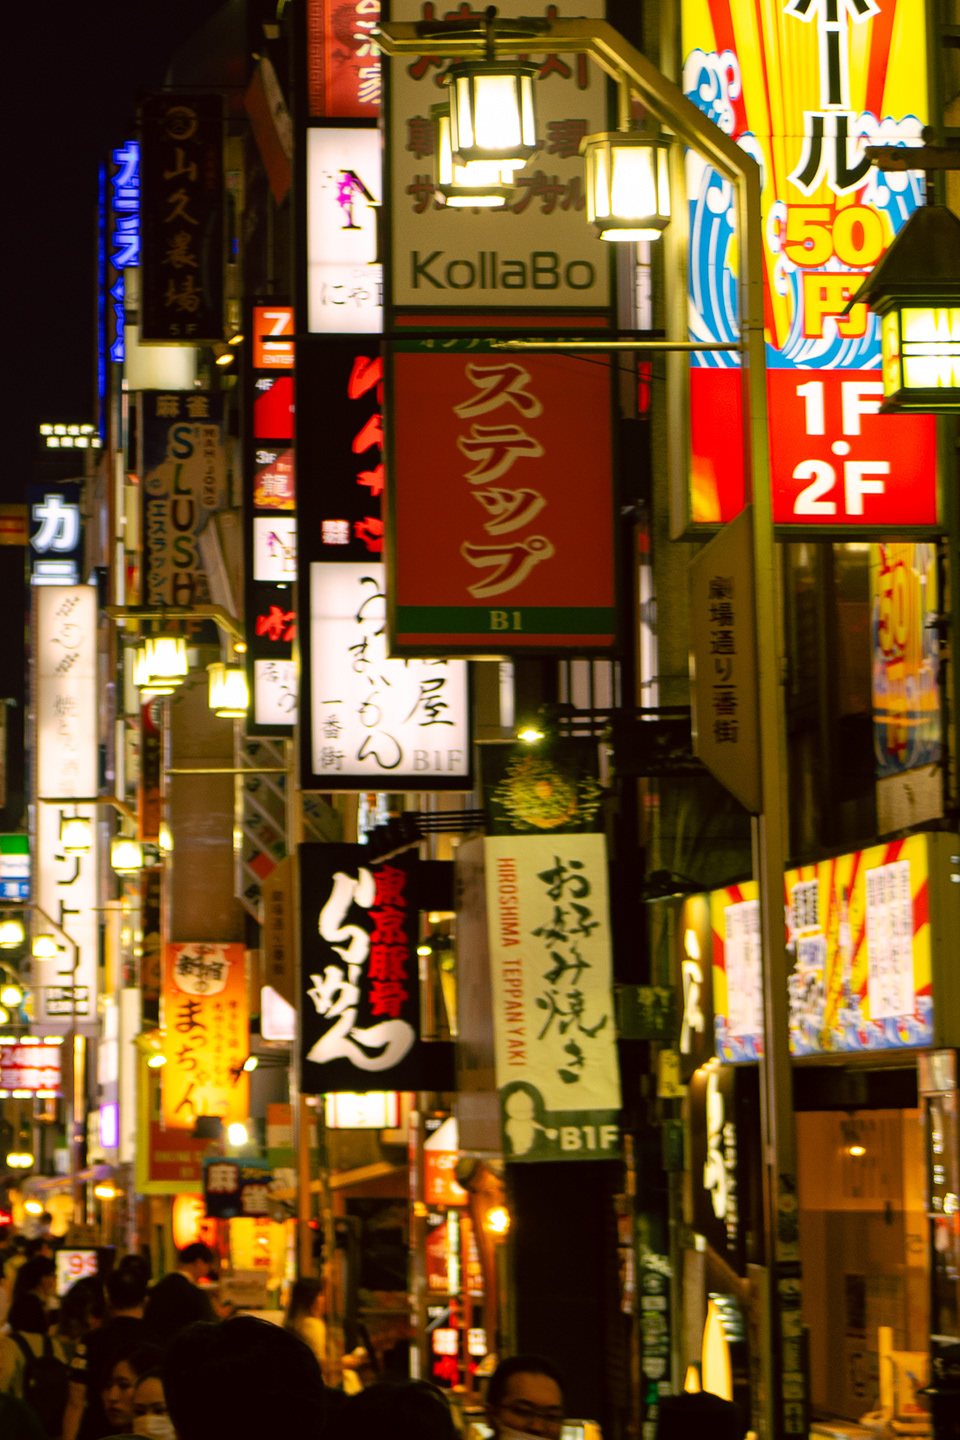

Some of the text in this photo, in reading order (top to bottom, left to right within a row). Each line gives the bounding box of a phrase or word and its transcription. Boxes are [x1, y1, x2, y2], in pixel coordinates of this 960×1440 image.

[784, 203, 885, 269] 50
[409, 251, 595, 290] KollaBo
[168, 323, 199, 336] 5F
[800, 271, 870, 340] 円
[156, 394, 211, 419] 麻雀
[796, 380, 884, 436] 1F
[453, 362, 555, 599] ステップ
[792, 459, 890, 516] 2F
[489, 610, 524, 631] B1
[411, 748, 463, 773] B1F
[496, 857, 521, 948] HIROSHIMA
[532, 856, 608, 1085] お好み焼き
[559, 1125, 619, 1152] B1F
